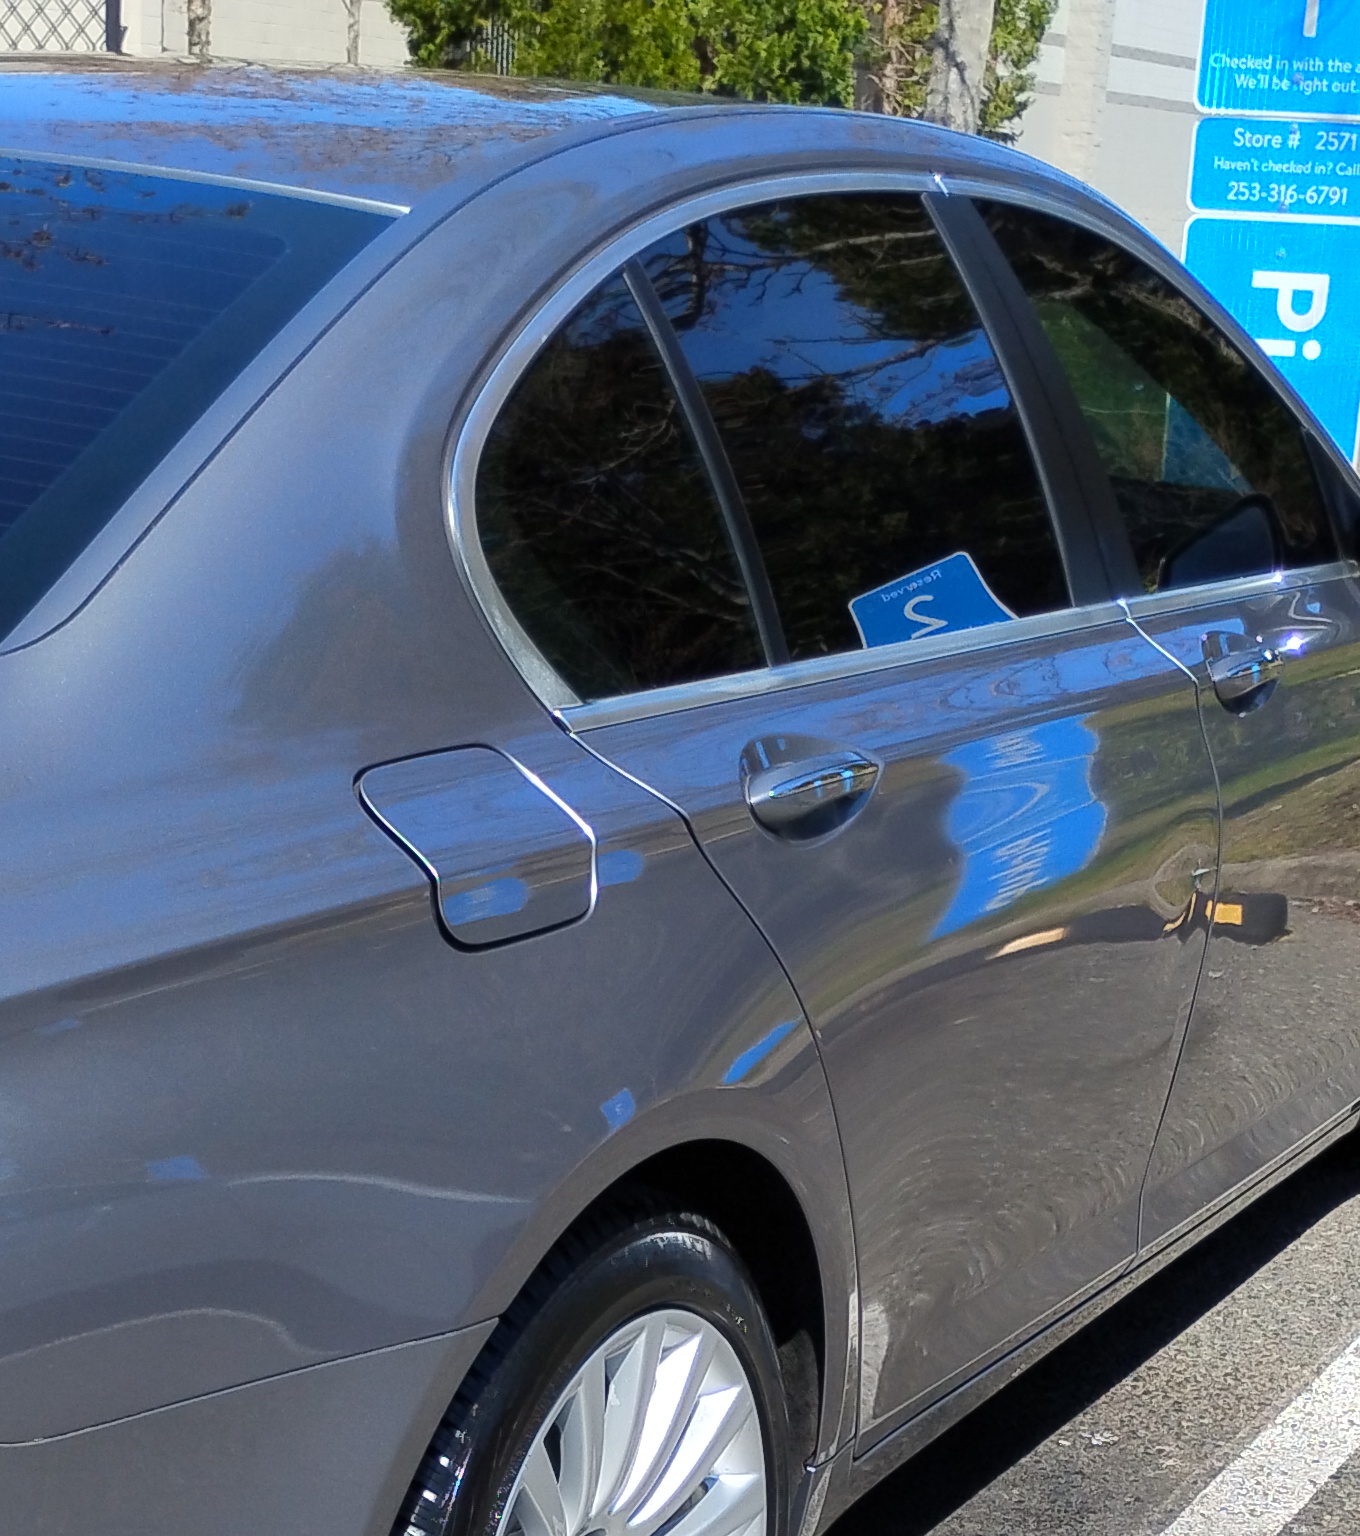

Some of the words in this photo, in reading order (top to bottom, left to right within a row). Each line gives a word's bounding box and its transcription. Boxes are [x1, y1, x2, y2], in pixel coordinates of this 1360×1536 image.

[1209, 53, 1272, 69] Checked
[1275, 55, 1289, 70] in
[1293, 57, 1324, 71] with
[1328, 58, 1353, 73] the
[1235, 73, 1269, 89] We'll
[1272, 75, 1290, 91] be
[1233, 127, 1282, 148] Store
[1288, 130, 1301, 150] #
[1315, 131, 1358, 151] 2571
[1213, 156, 1259, 172] Haven't
[1261, 160, 1312, 174] checked
[1314, 162, 1334, 175] in?
[1226, 181, 1348, 205] 253-316-6791
